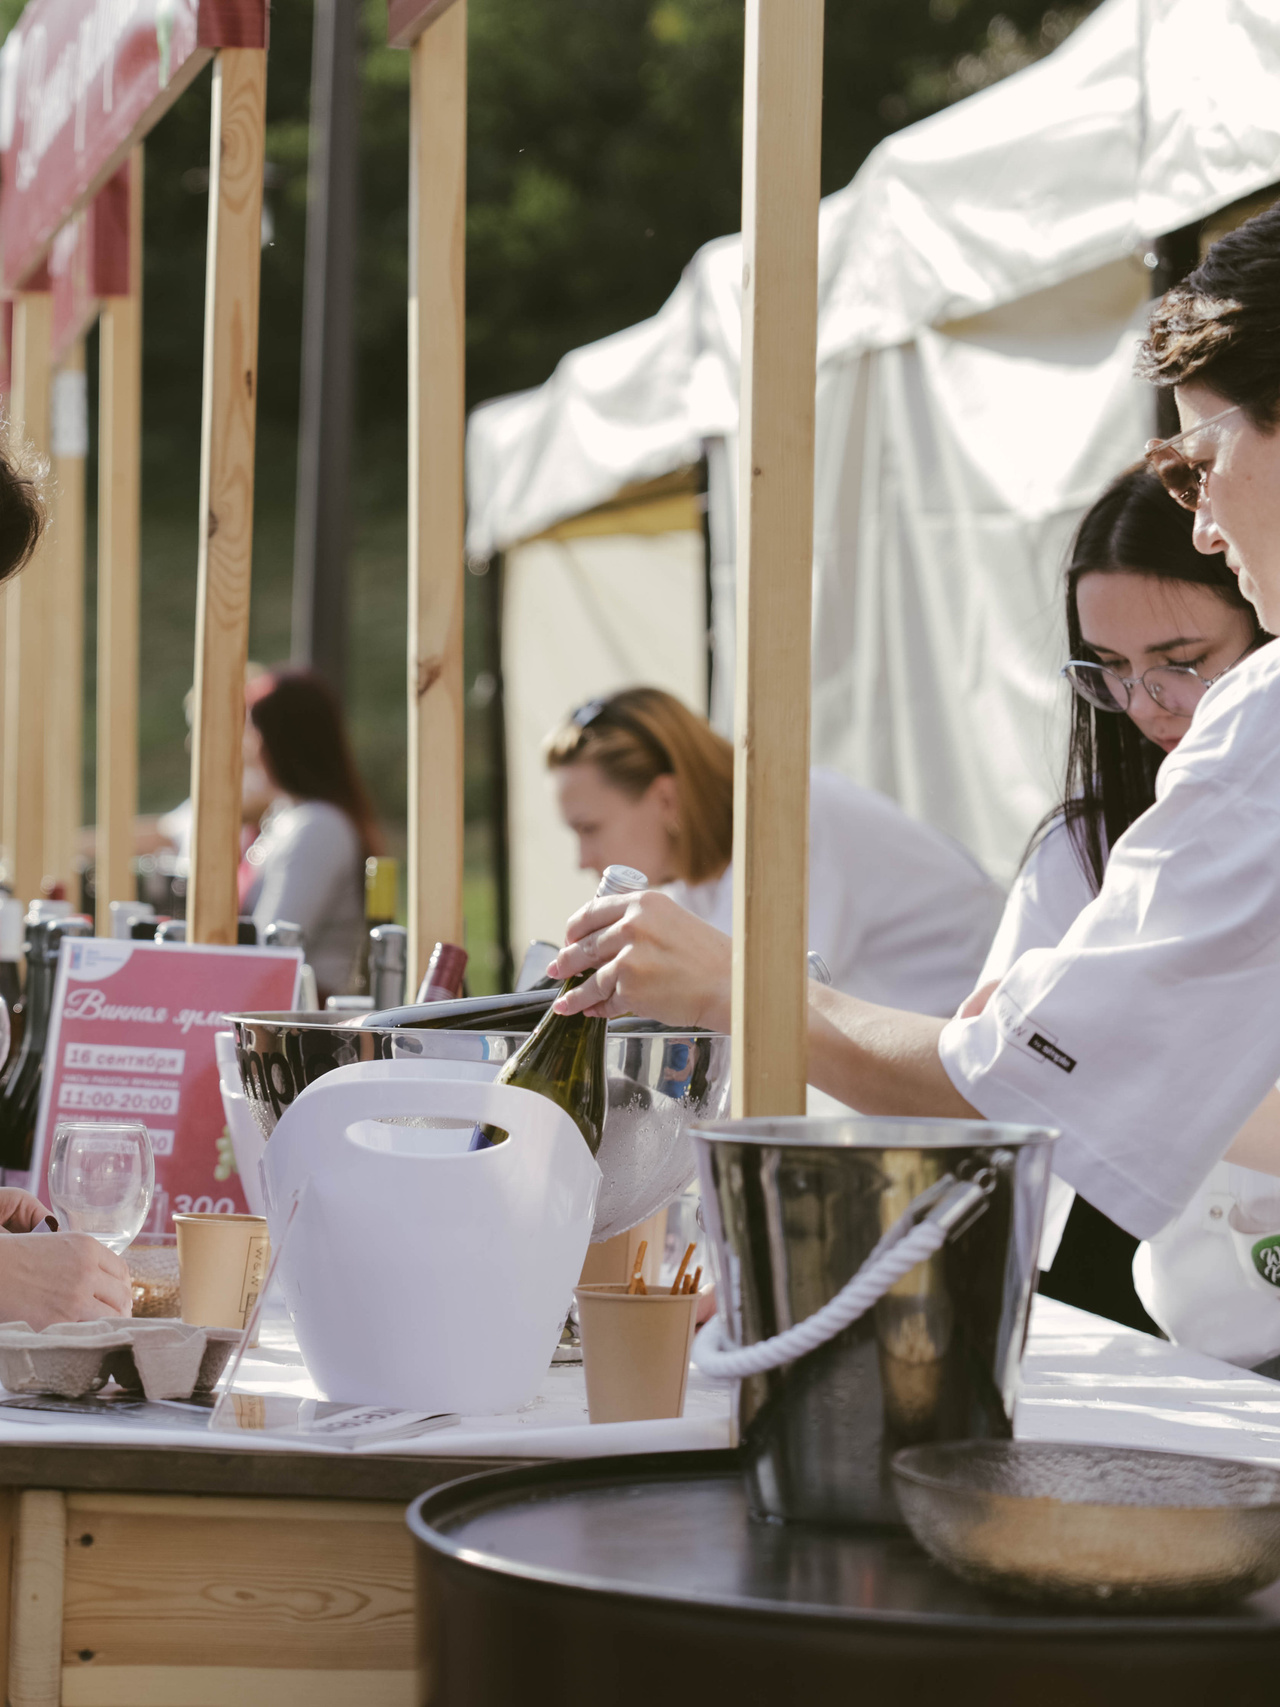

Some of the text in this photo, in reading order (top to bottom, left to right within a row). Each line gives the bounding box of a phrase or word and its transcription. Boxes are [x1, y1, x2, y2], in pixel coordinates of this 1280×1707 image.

[63, 988, 169, 1024] Винная
[71, 1050, 178, 1073] 16 сентября
